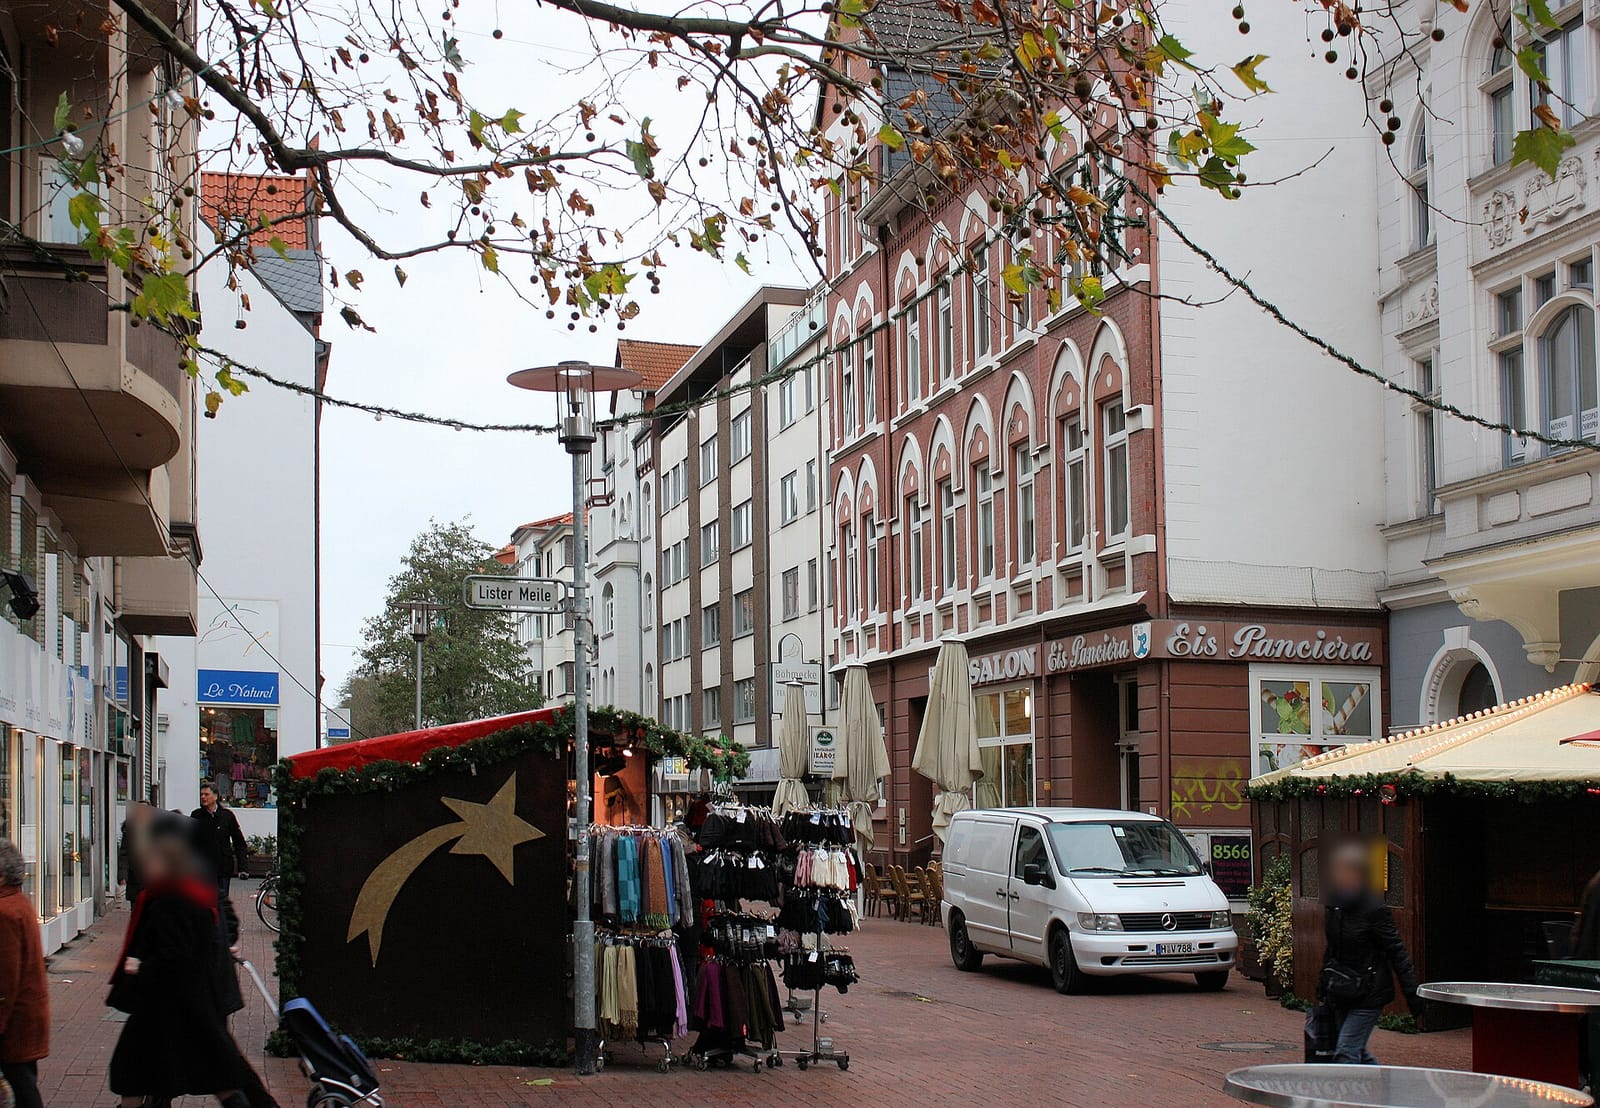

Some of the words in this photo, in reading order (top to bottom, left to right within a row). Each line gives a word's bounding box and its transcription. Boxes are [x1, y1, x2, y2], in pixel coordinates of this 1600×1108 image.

[478, 584, 513, 601] Lister
[518, 586, 552, 603] Meile
[1167, 623, 1218, 657] Eis
[1228, 624, 1373, 662] Panciera
[1047, 640, 1067, 673] Eis
[1069, 633, 1130, 668] Panciera
[775, 669, 817, 680] Böhmecke
[969, 647, 1036, 685] SALON
[203, 682, 225, 698] Le
[228, 684, 274, 699] Naturel
[1213, 844, 1250, 860] 8566
